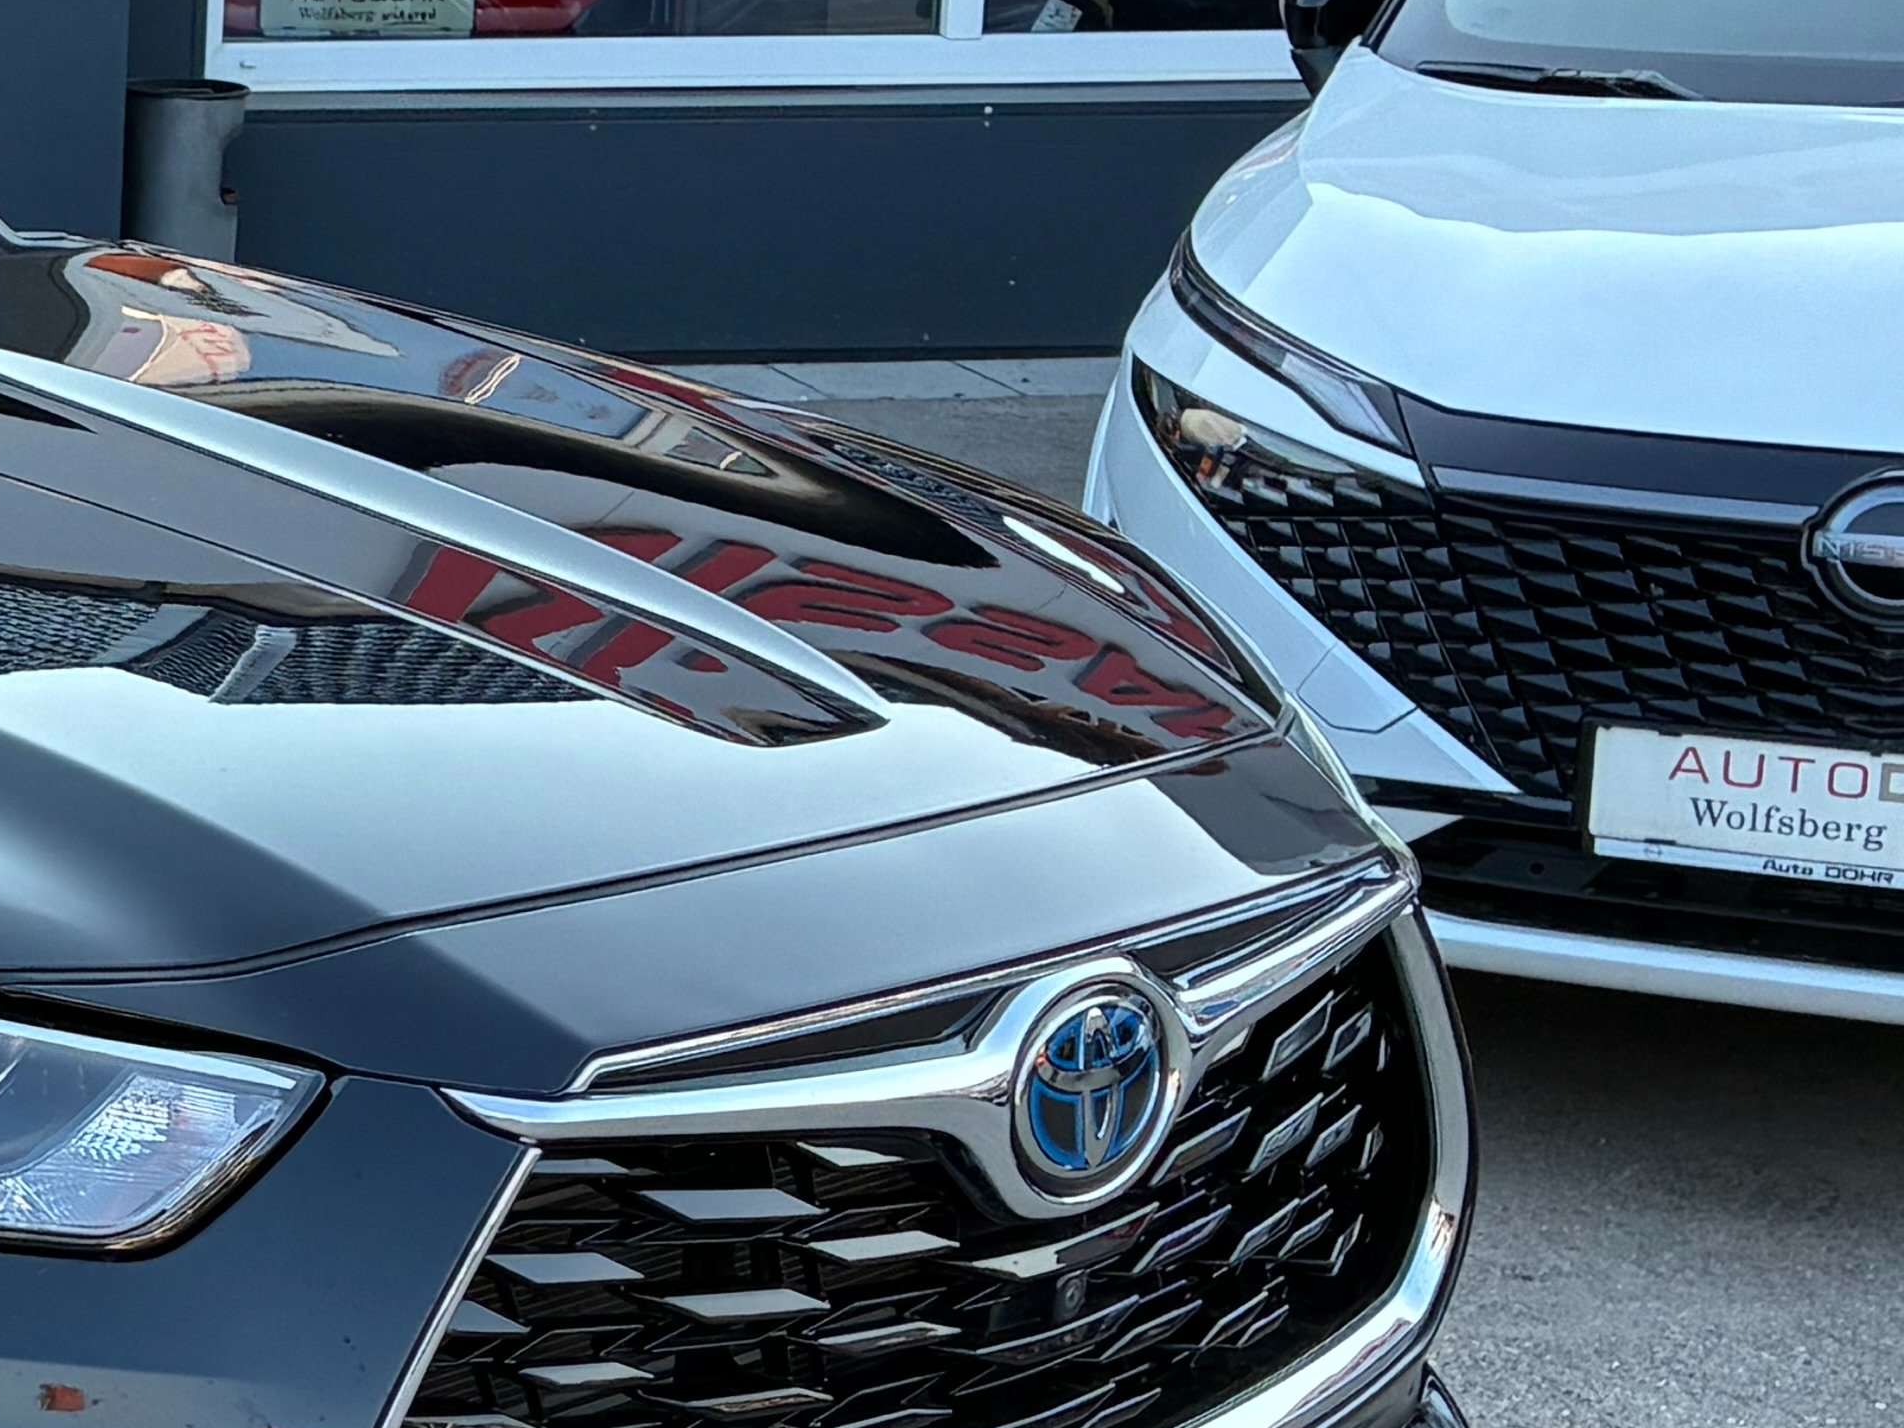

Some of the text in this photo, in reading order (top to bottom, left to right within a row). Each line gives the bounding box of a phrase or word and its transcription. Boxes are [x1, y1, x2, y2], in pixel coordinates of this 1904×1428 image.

[1690, 797, 1888, 851] Wolfsberg
[1762, 858, 1894, 884] Auto DOHR
